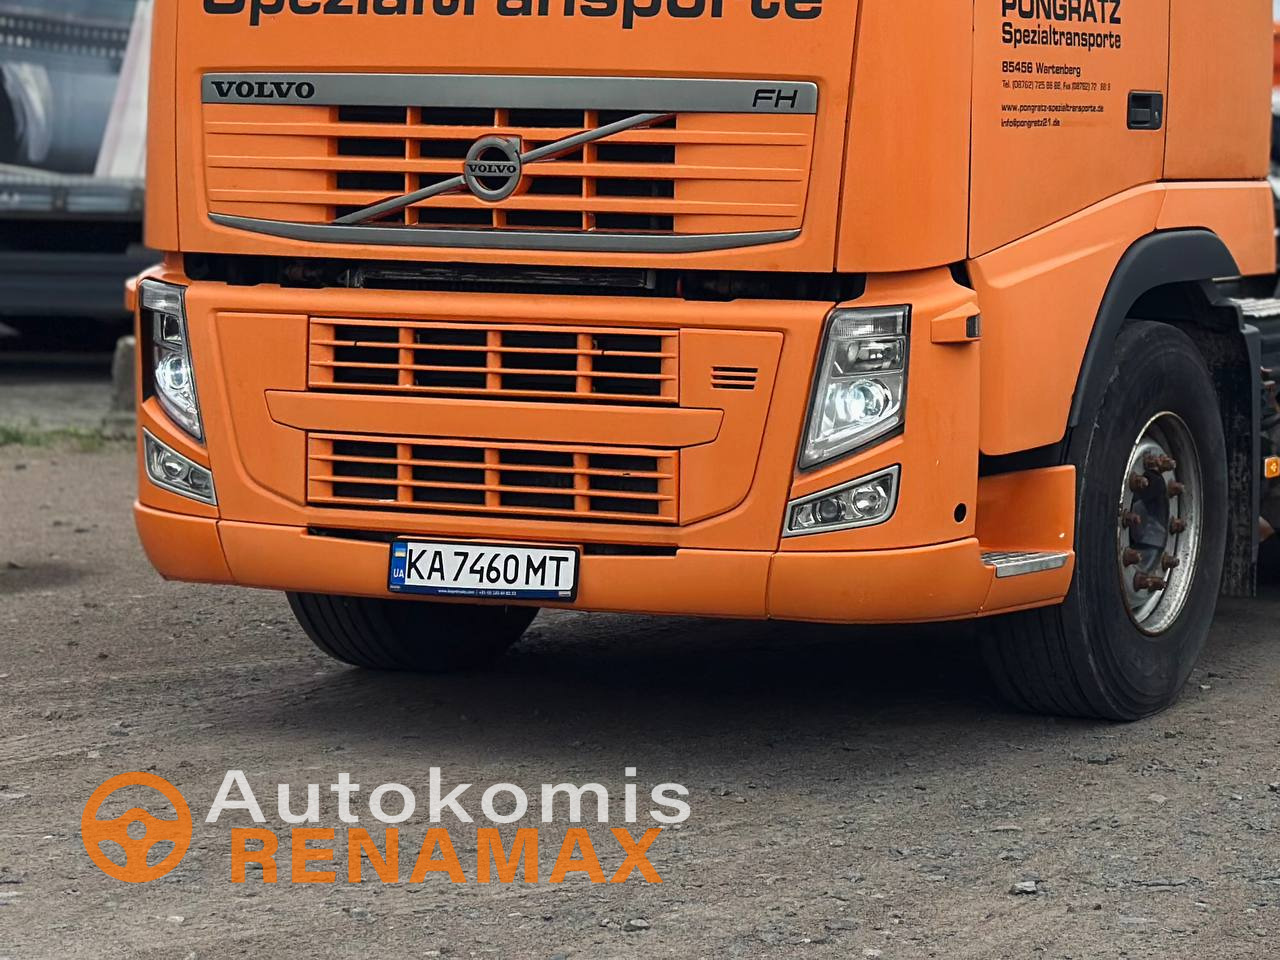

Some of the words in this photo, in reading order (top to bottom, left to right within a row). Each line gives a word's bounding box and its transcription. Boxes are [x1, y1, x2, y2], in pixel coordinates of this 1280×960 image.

[1001, 21, 1121, 52] Spezialtransporte
[210, 79, 315, 100] VOLVO
[751, 88, 799, 109] FH
[468, 162, 518, 176] VOLVO
[393, 568, 405, 580] UA
[406, 548, 446, 582] KA
[452, 551, 520, 585] 7460
[525, 554, 569, 588] MT
